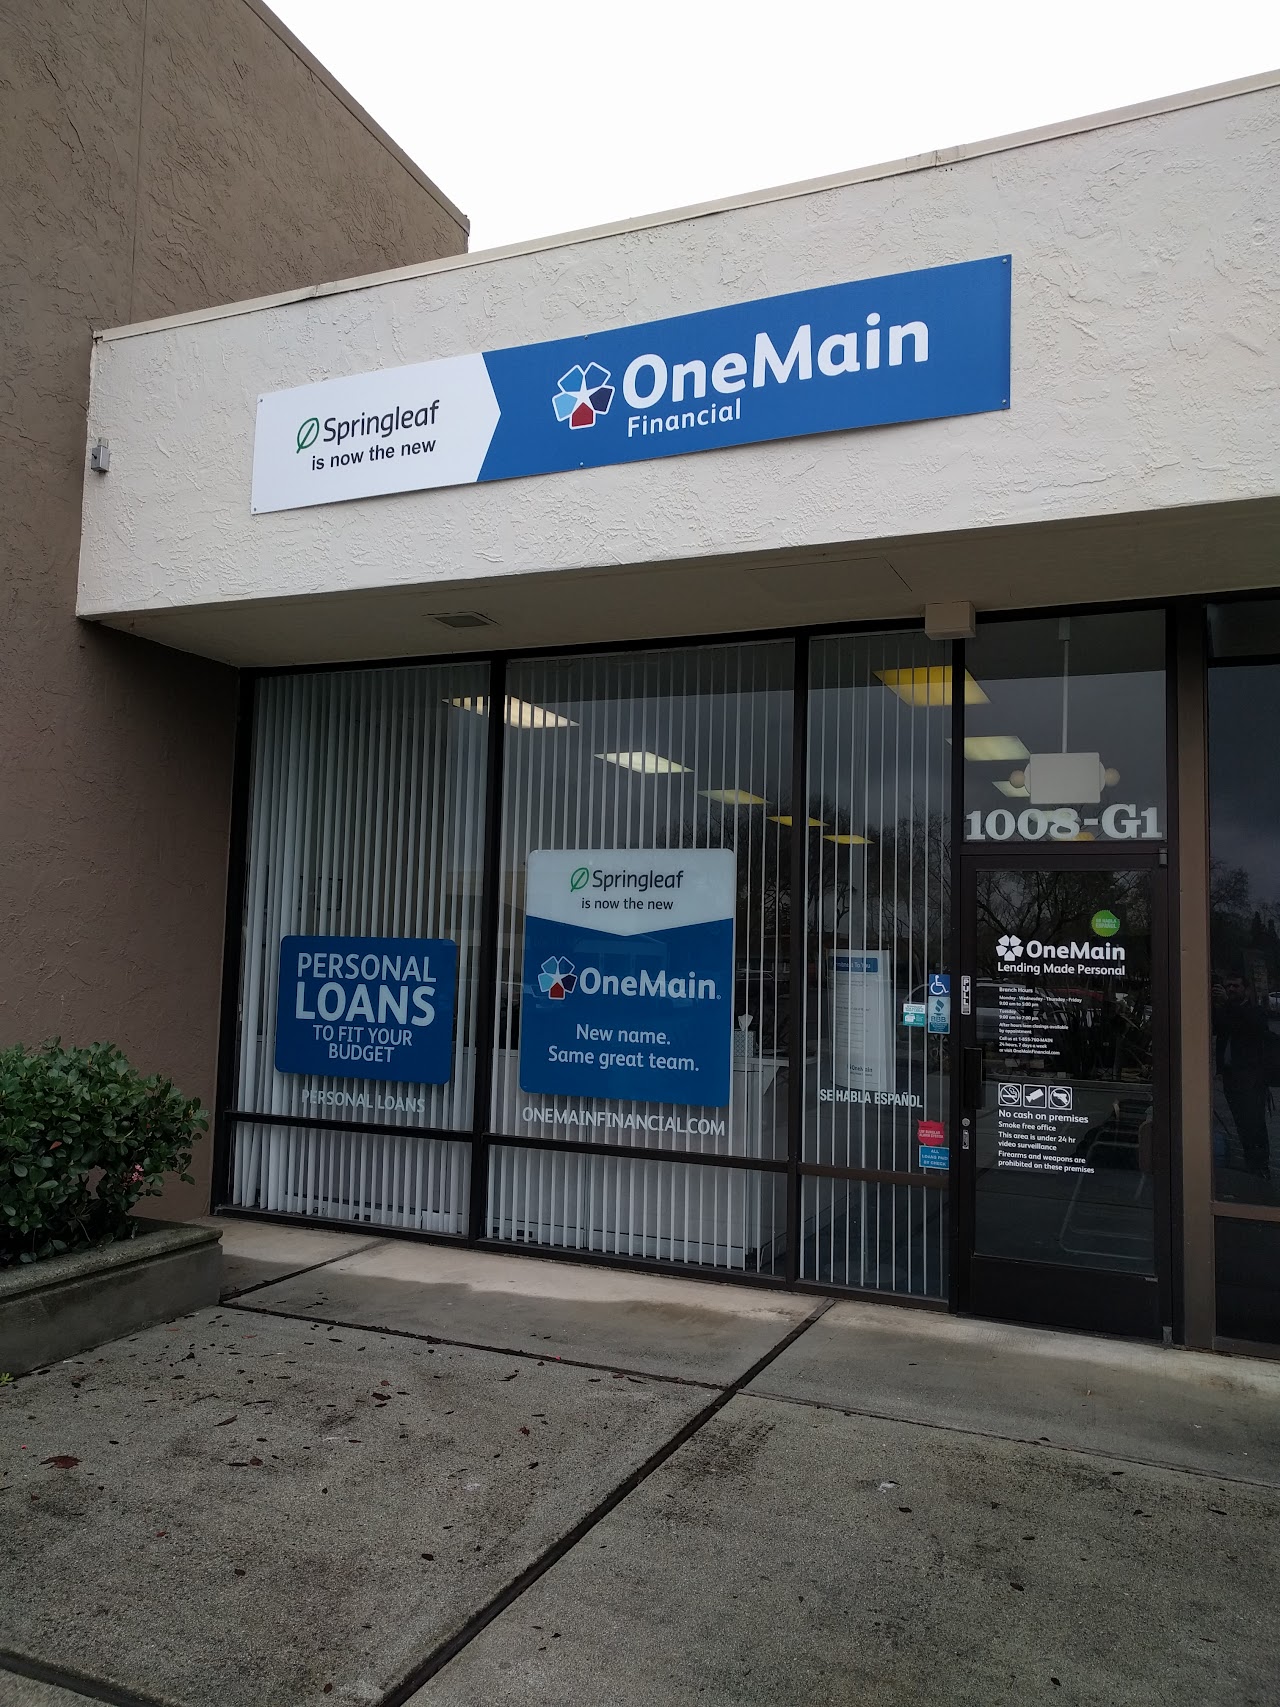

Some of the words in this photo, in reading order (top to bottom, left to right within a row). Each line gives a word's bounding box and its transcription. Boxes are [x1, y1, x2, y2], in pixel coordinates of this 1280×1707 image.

[622, 312, 929, 409] OneMain
[323, 400, 440, 445] Springleaf
[627, 398, 741, 438] Financial
[312, 455, 325, 471] is
[330, 450, 364, 468] now
[369, 444, 395, 463] the
[400, 439, 436, 457] new
[966, 803, 1162, 840] 1008-G1
[592, 869, 684, 892] Springleaf
[581, 897, 591, 909] is
[594, 899, 619, 910] now
[623, 897, 644, 910] the
[647, 900, 674, 910] new
[1026, 940, 1126, 961] OneMain
[297, 952, 437, 983] PERSONAL
[997, 962, 1040, 975] Lending
[1043, 963, 1075, 975] Made
[1078, 964, 1126, 976] Personal
[295, 981, 436, 1027] LOANS
[313, 1025, 334, 1041] TO
[338, 1026, 364, 1043] FIT
[368, 1028, 413, 1046] YOUR
[576, 1023, 613, 1042] New
[618, 1029, 671, 1045] name.
[328, 1043, 395, 1063] BUDGET
[548, 1046, 594, 1064] Same
[599, 1050, 644, 1070] great
[649, 1054, 699, 1072] team.
[301, 1089, 374, 1108] PERSONAL
[377, 1095, 426, 1113] LOANS
[820, 1089, 833, 1102] SE
[836, 1089, 872, 1104] HABLA
[874, 1092, 923, 1108] ESPAÑOL
[998, 1109, 1012, 1118] No
[1013, 1111, 1033, 1119] cash
[1049, 1114, 1089, 1124] premises
[998, 1121, 1021, 1129] Smoke
[1022, 1122, 1036, 1130] free
[1036, 1124, 1057, 1132] office
[1017, 1142, 1057, 1151] surveillance
[1037, 1134, 1057, 1142] under
[1057, 1135, 1067, 1143] 24
[1068, 1136, 1077, 1144] hr
[998, 1150, 1027, 1159] Firearms
[1028, 1153, 1042, 1161] and
[1042, 1155, 1073, 1164] weapons
[998, 1159, 1033, 1168] prohibited
[1044, 1163, 1063, 1171] these
[1063, 1166, 1096, 1174] premises
